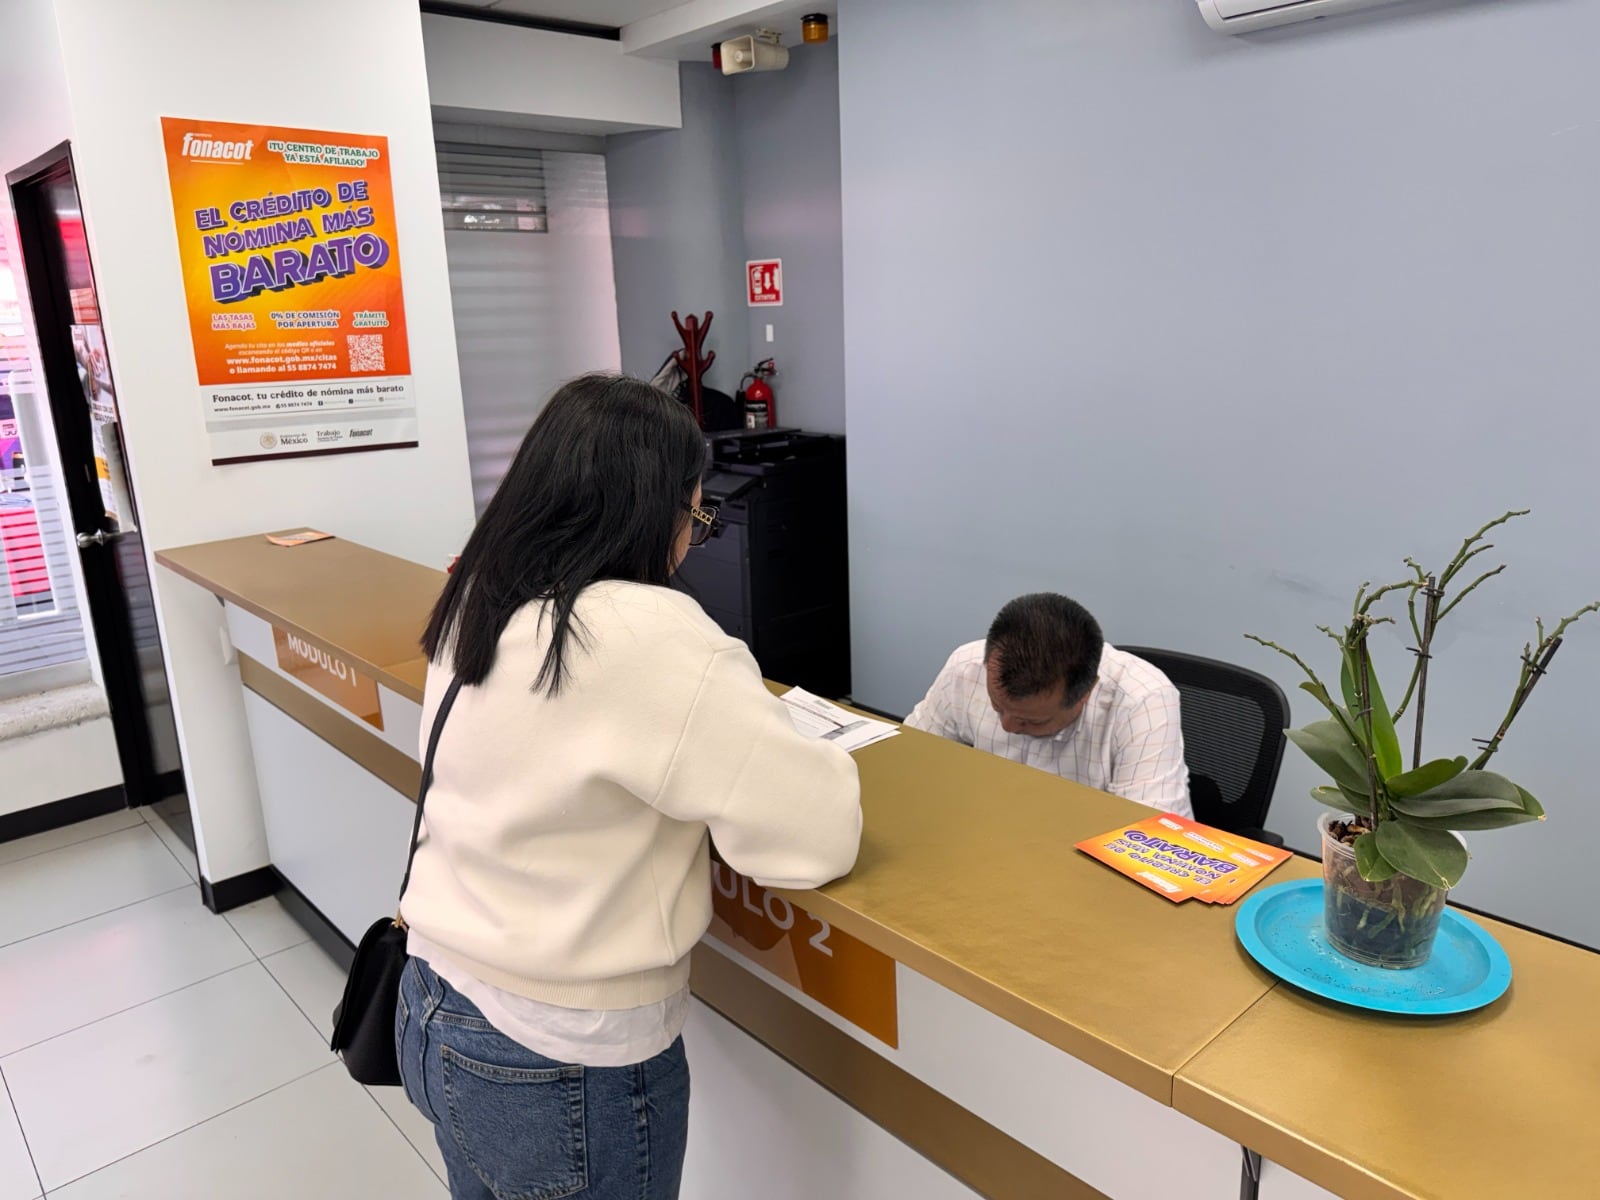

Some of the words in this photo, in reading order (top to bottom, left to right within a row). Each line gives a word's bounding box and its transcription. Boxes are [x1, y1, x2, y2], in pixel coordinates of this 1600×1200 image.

[182, 132, 254, 160] fonacot
[286, 144, 322, 154] CENTRO
[325, 146, 337, 156] DE
[340, 148, 378, 158] TRABAJO
[284, 152, 296, 162] YA
[300, 153, 320, 164] ESTÁ
[324, 155, 366, 166] AFILIADO!
[194, 207, 226, 230] EL
[230, 189, 332, 223] CRÉDITO
[337, 181, 368, 203] DE
[203, 218, 316, 258] NÓMINA
[322, 206, 374, 234] MÁS
[209, 233, 389, 303] BARATO
[298, 310, 340, 319] COMISIÓN
[233, 322, 256, 330] BAJAS
[295, 320, 338, 328] APERTURA
[226, 354, 337, 365] www.fonacot.gob.mx/citas
[236, 365, 276, 374] llamando
[270, 390, 304, 399] crédito
[320, 388, 354, 396] nómina
[356, 386, 374, 394] más
[1124, 830, 1240, 874] BARATO
[807, 910, 833, 958] 2
